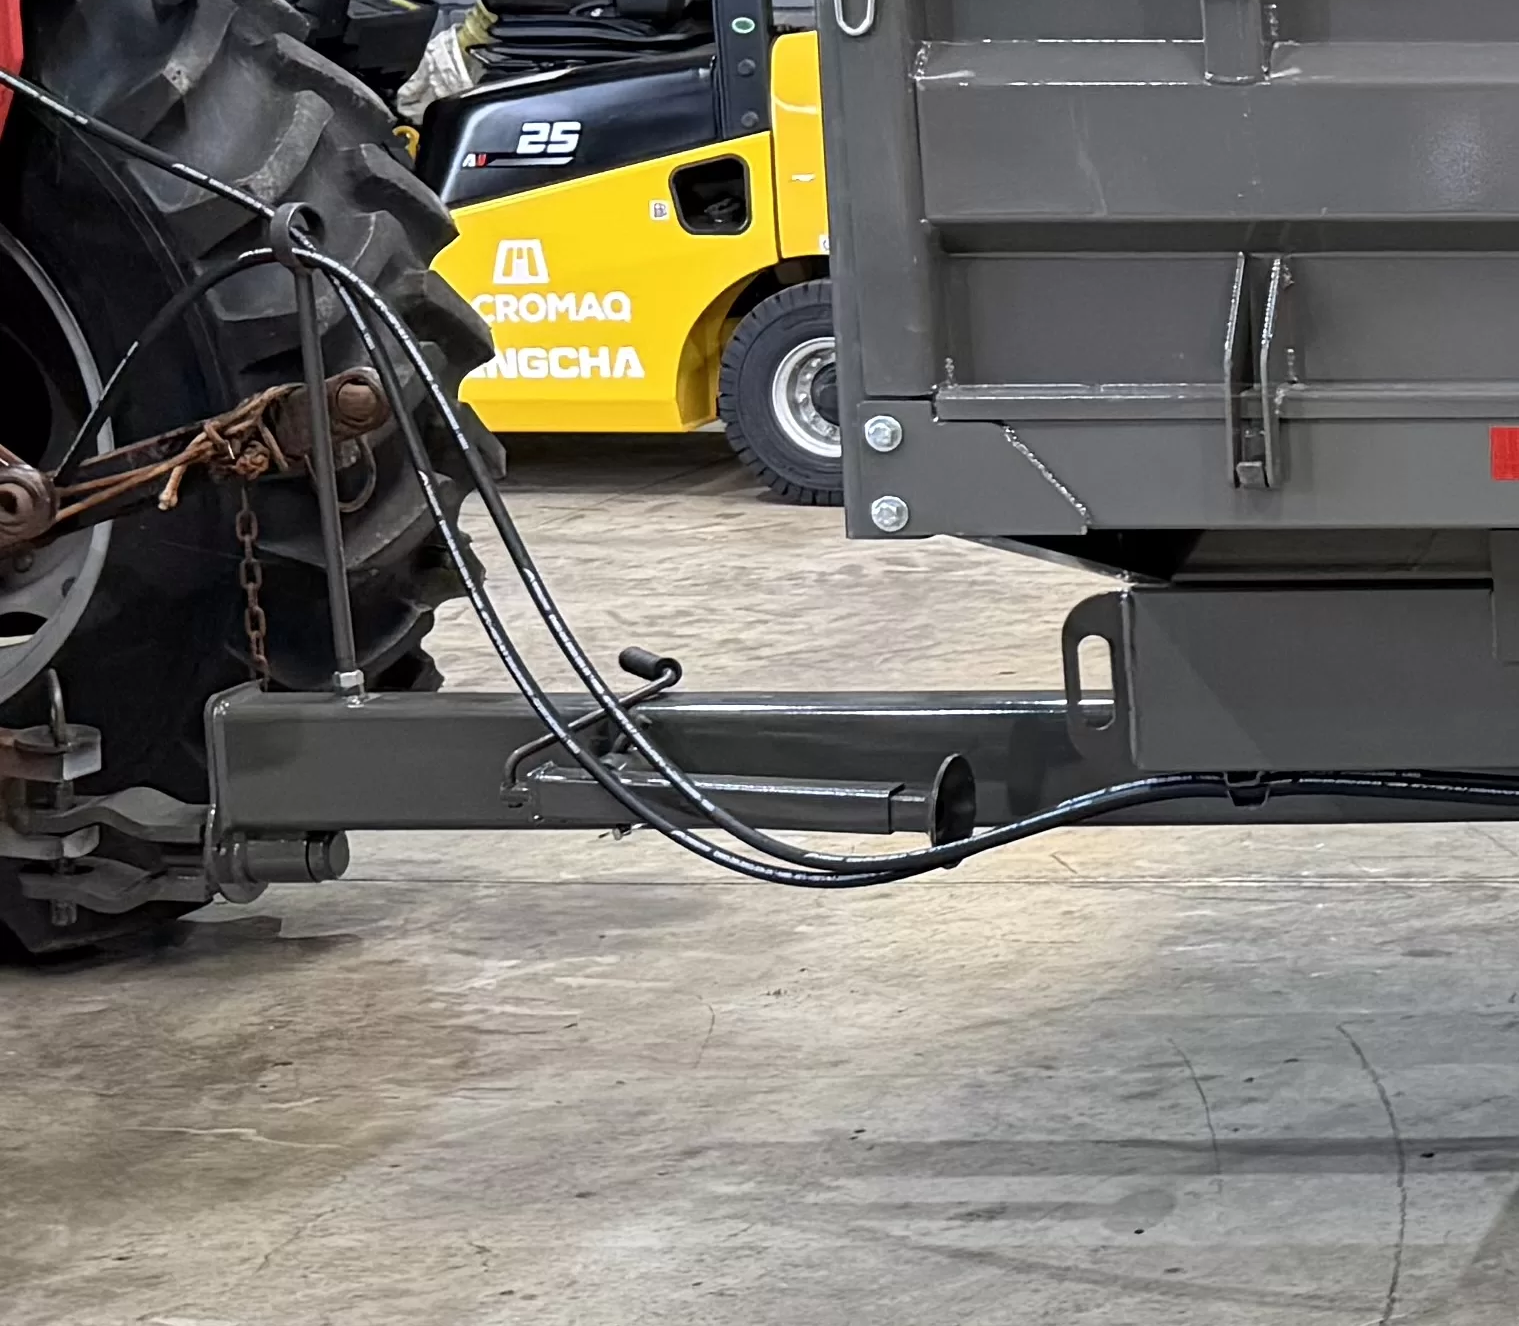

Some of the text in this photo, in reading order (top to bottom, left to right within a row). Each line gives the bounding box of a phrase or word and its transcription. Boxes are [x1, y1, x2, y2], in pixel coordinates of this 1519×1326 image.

[515, 121, 582, 154] 25
[470, 290, 633, 324] CROMAQ
[467, 346, 646, 379] NGCHA
